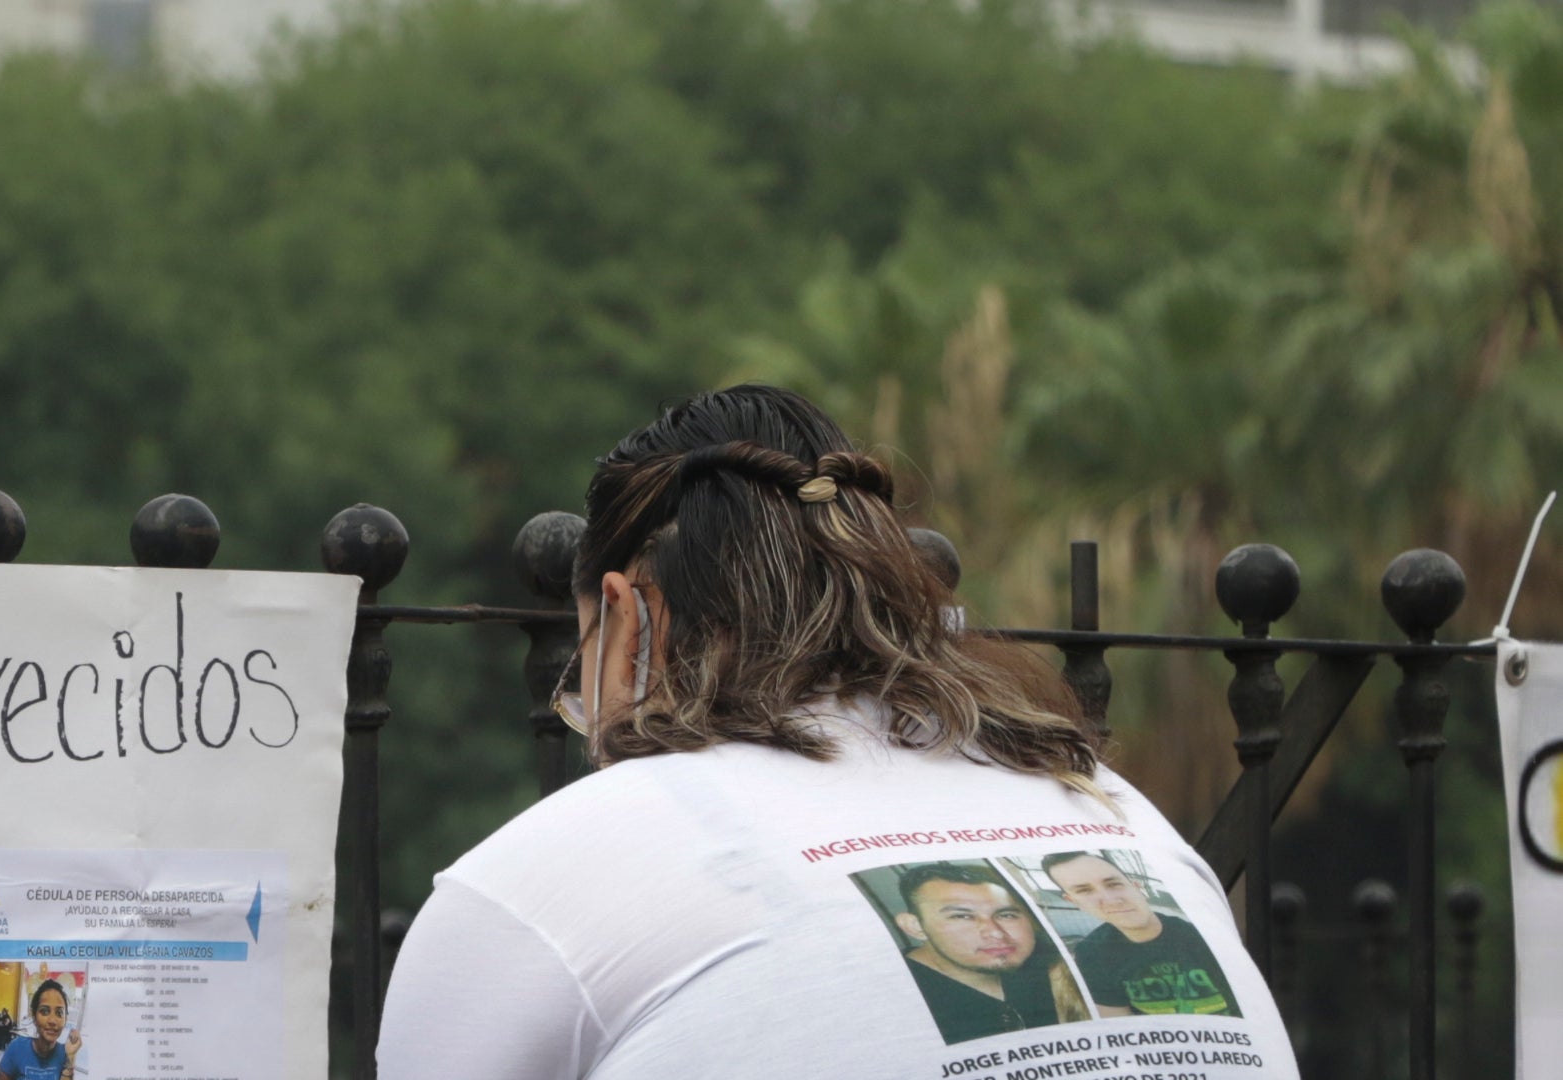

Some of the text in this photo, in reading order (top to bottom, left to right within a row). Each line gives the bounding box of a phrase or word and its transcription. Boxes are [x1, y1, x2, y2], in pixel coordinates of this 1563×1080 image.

[801, 823, 1135, 864] INGENIEROS REGIOMONTANOS
[26, 886, 225, 904] CÉDULA DE PERSONA DESAPARECIDA
[111, 906, 118, 916] A
[164, 907, 170, 917] A
[84, 919, 97, 929] SU
[99, 919, 136, 929] FAMILIA
[27, 945, 67, 958] KARLA
[70, 945, 115, 958] CECILIA
[172, 946, 214, 959] CAVAZOS
[941, 1029, 1252, 1079] JORGE AREVALO / RICARDO VALDES
[1135, 1051, 1198, 1068] NUEVO
[1201, 1050, 1263, 1068] LAREDO
